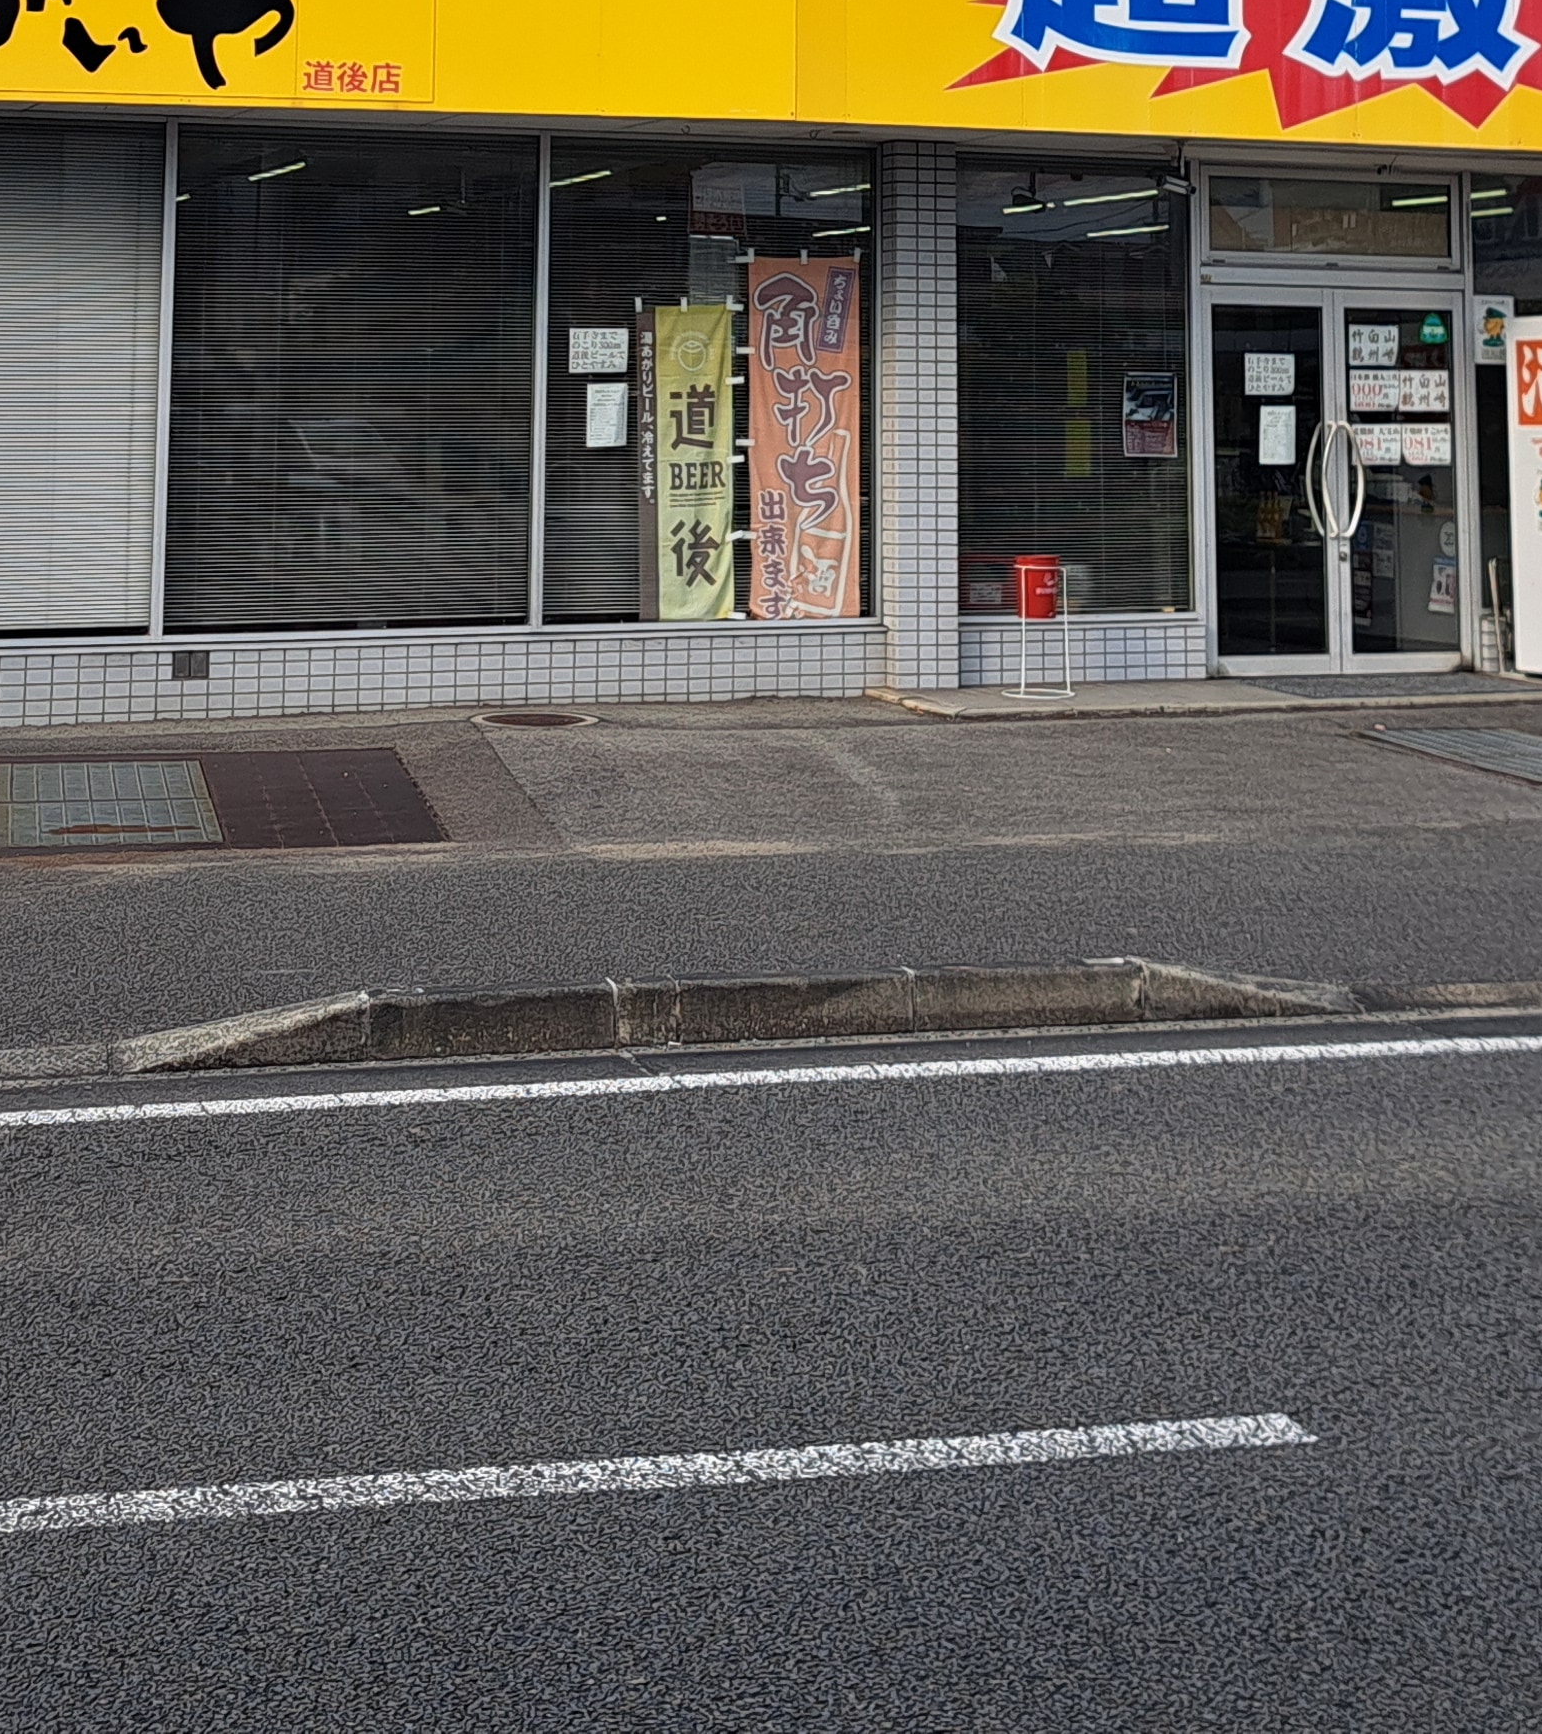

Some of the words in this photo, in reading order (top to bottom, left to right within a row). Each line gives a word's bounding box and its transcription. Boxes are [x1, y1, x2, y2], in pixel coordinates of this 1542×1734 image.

[301, 60, 403, 95] 道後店
[1368, 329, 1380, 362] 白州
[1382, 329, 1396, 362] 山崎
[752, 271, 852, 532] 角打ち
[1418, 374, 1431, 408] 白州
[1434, 374, 1447, 408] 山崎
[669, 383, 716, 451] 道
[669, 460, 727, 491] BEER
[669, 519, 722, 589] 後
[757, 488, 792, 620] 出来ます
